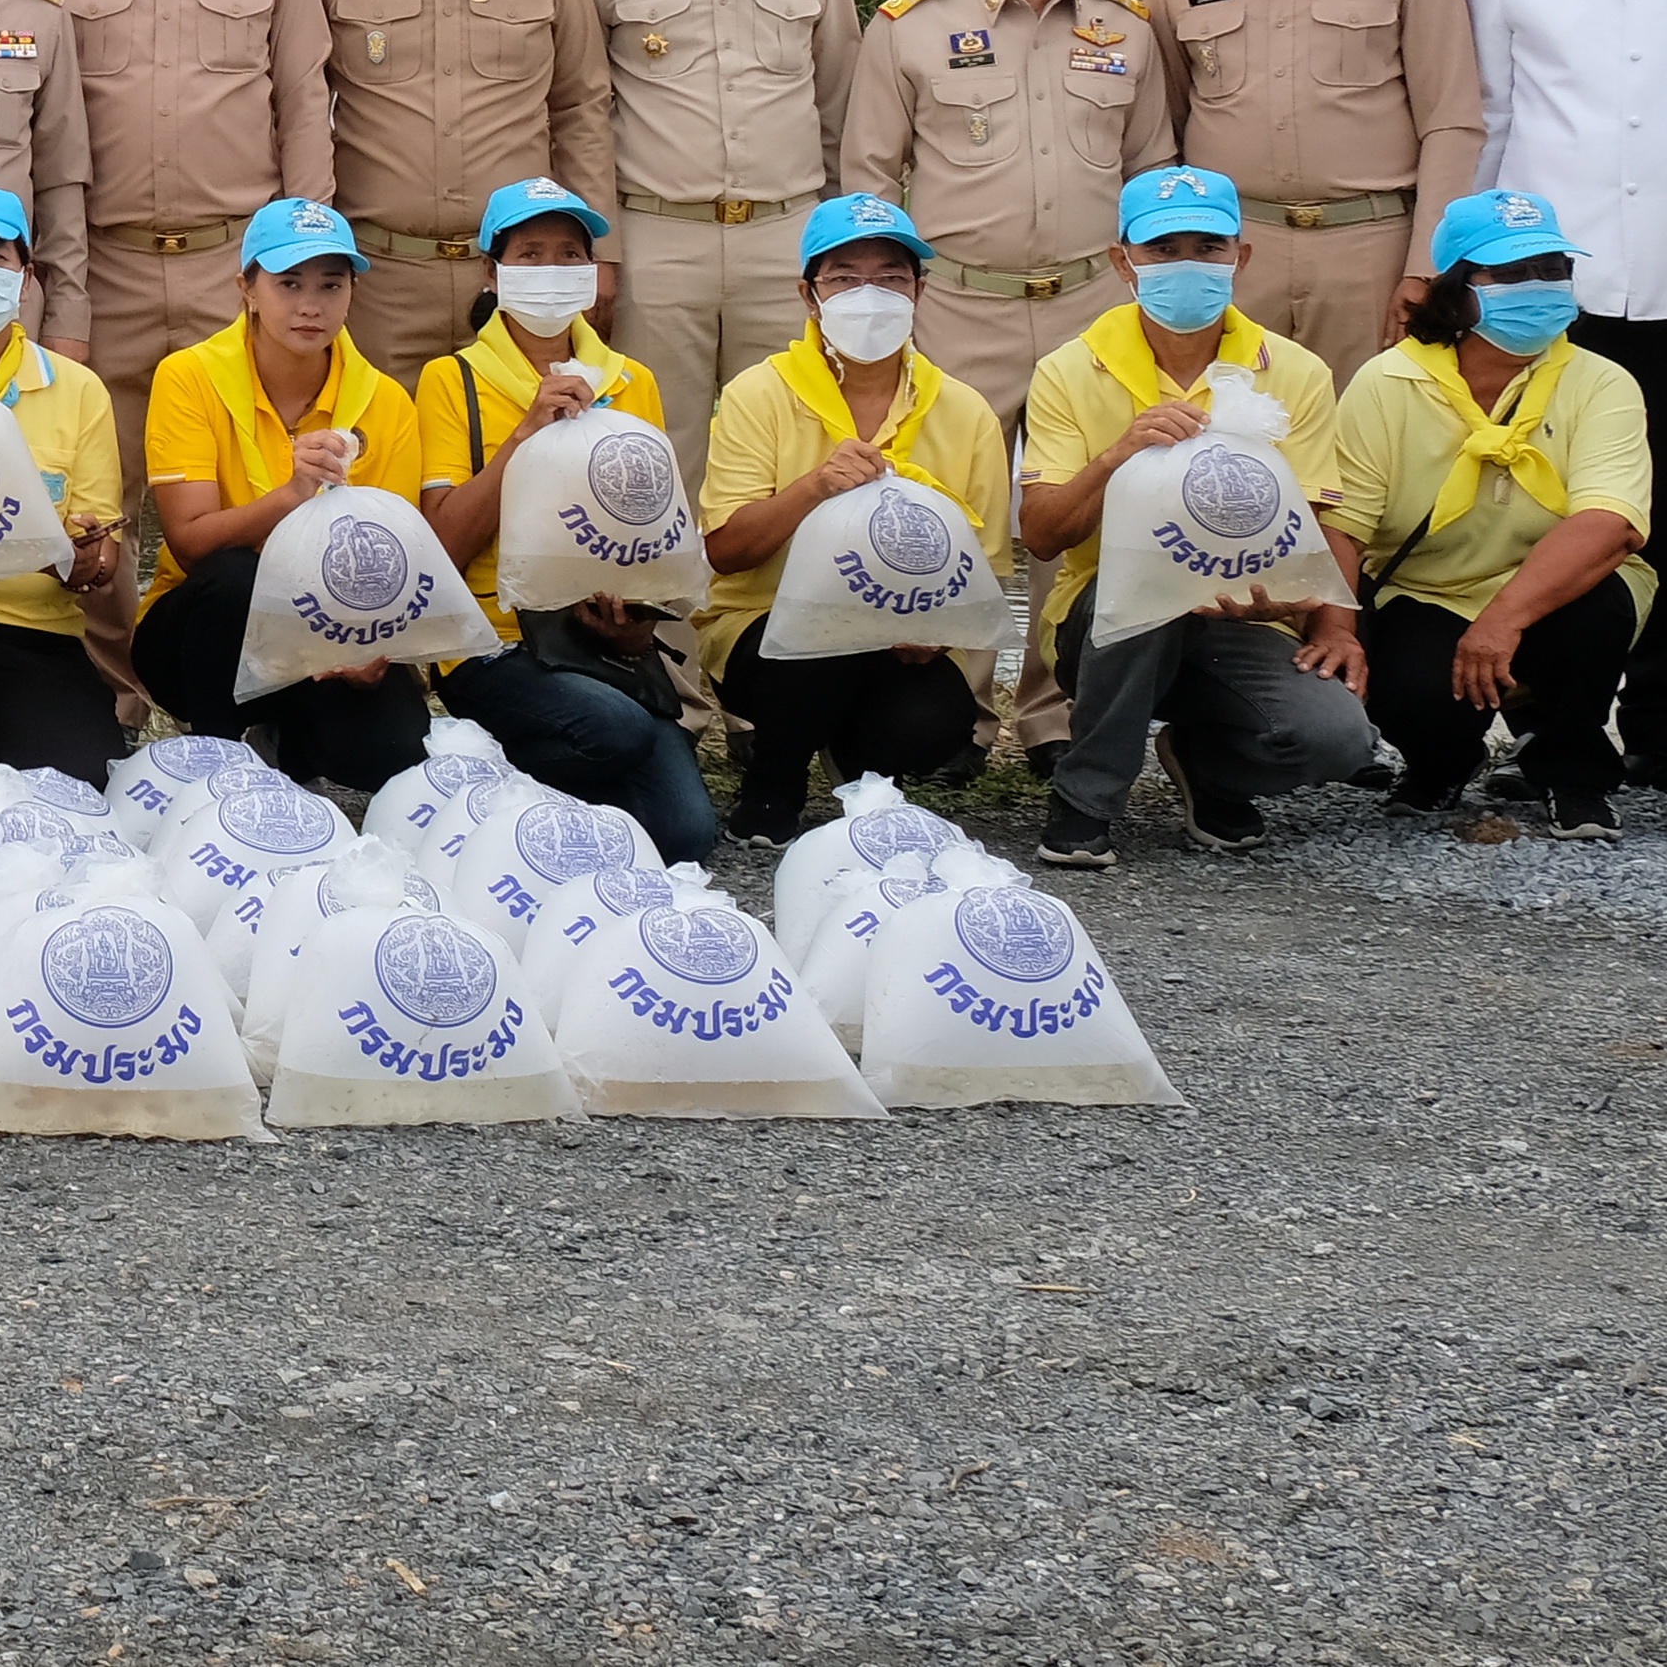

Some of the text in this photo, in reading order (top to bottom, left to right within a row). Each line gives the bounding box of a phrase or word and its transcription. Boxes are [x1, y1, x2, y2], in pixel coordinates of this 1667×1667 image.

[558, 503, 688, 564] กรมประมง
[1151, 507, 1303, 581] กรมประมง
[291, 571, 436, 645] กรมประมง
[832, 548, 974, 614] กรมประมง
[606, 964, 792, 1042] กรมประมง
[921, 959, 1101, 1039] กรมประมง
[3, 997, 201, 1084] กรมประมง
[336, 997, 523, 1081] กรมประมง
